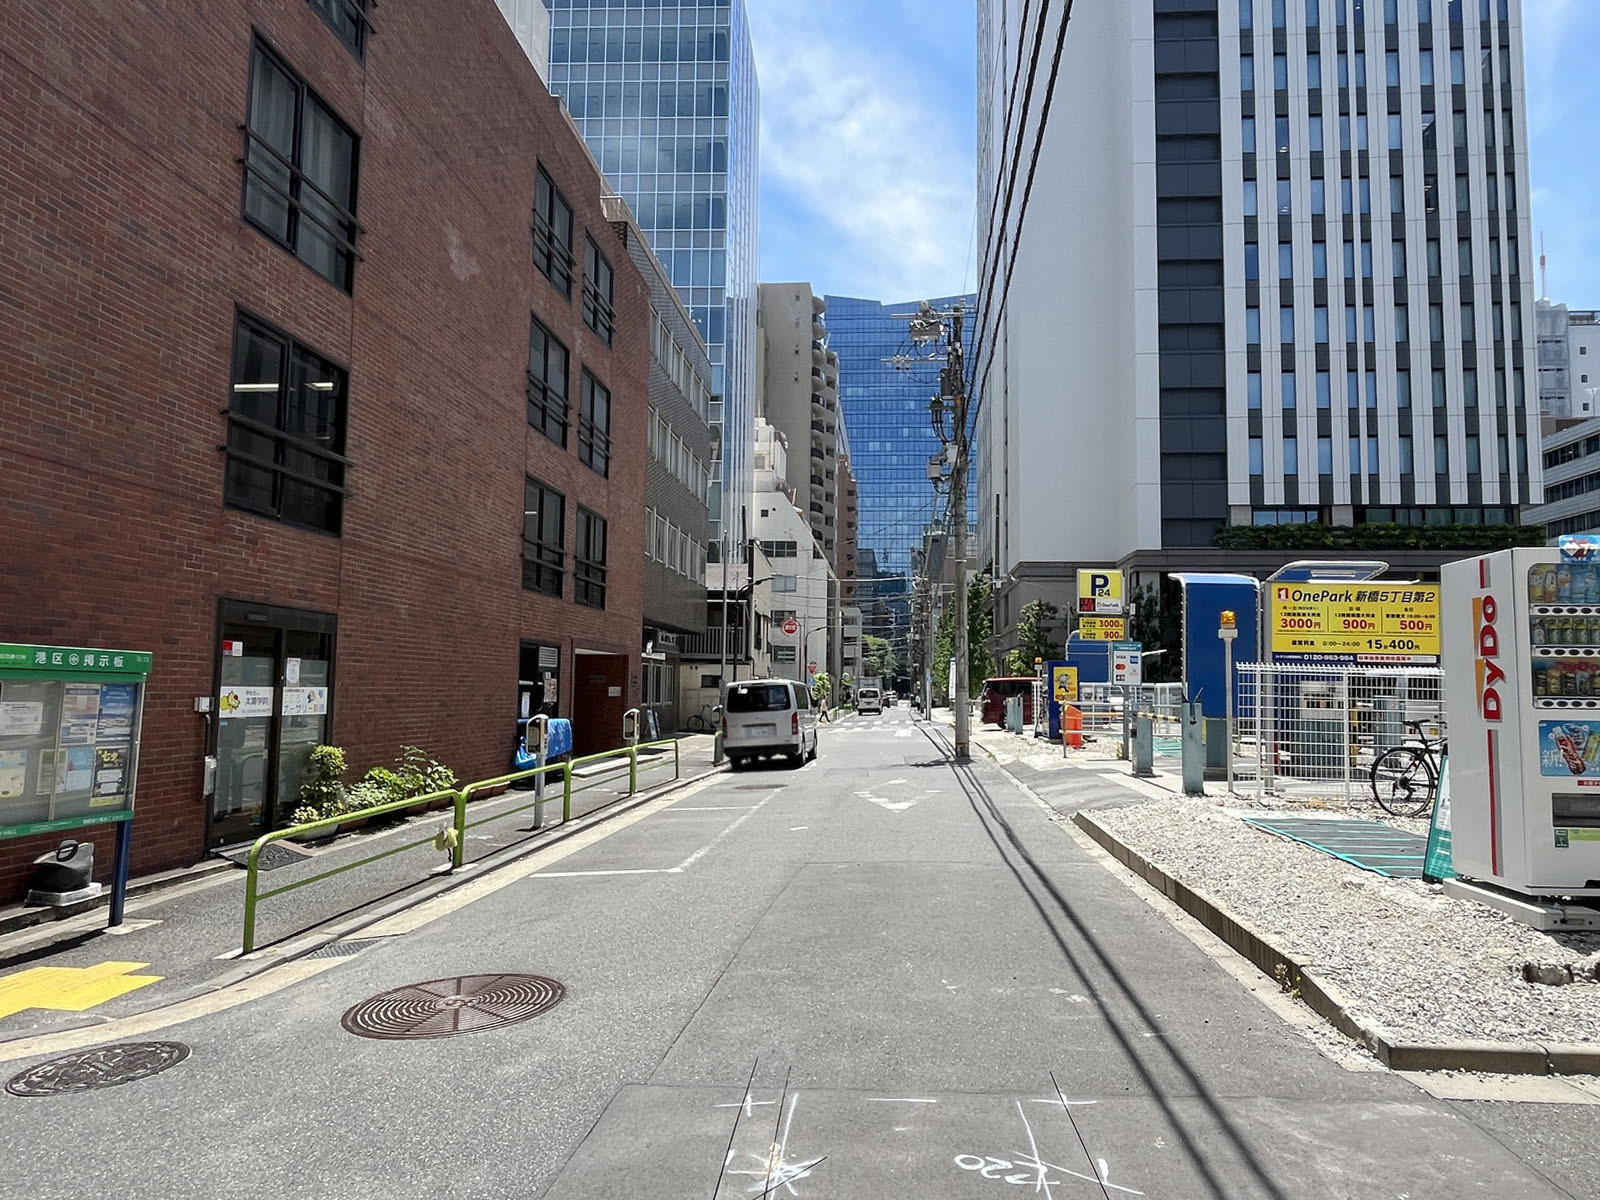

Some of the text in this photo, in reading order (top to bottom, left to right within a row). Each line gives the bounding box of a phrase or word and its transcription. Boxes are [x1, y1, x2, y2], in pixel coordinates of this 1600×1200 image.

[1091, 574, 1109, 596] P
[1097, 589, 1110, 597] 24
[1292, 590, 1352, 602] OnePark
[1355, 591, 1435, 603] 新橋5丁目第2
[1280, 618, 1321, 629] 3000円
[1342, 619, 1376, 630] 900円
[1399, 620, 1433, 631] 500円
[35, 651, 63, 665] 港区
[83, 653, 124, 668] 掲示板
